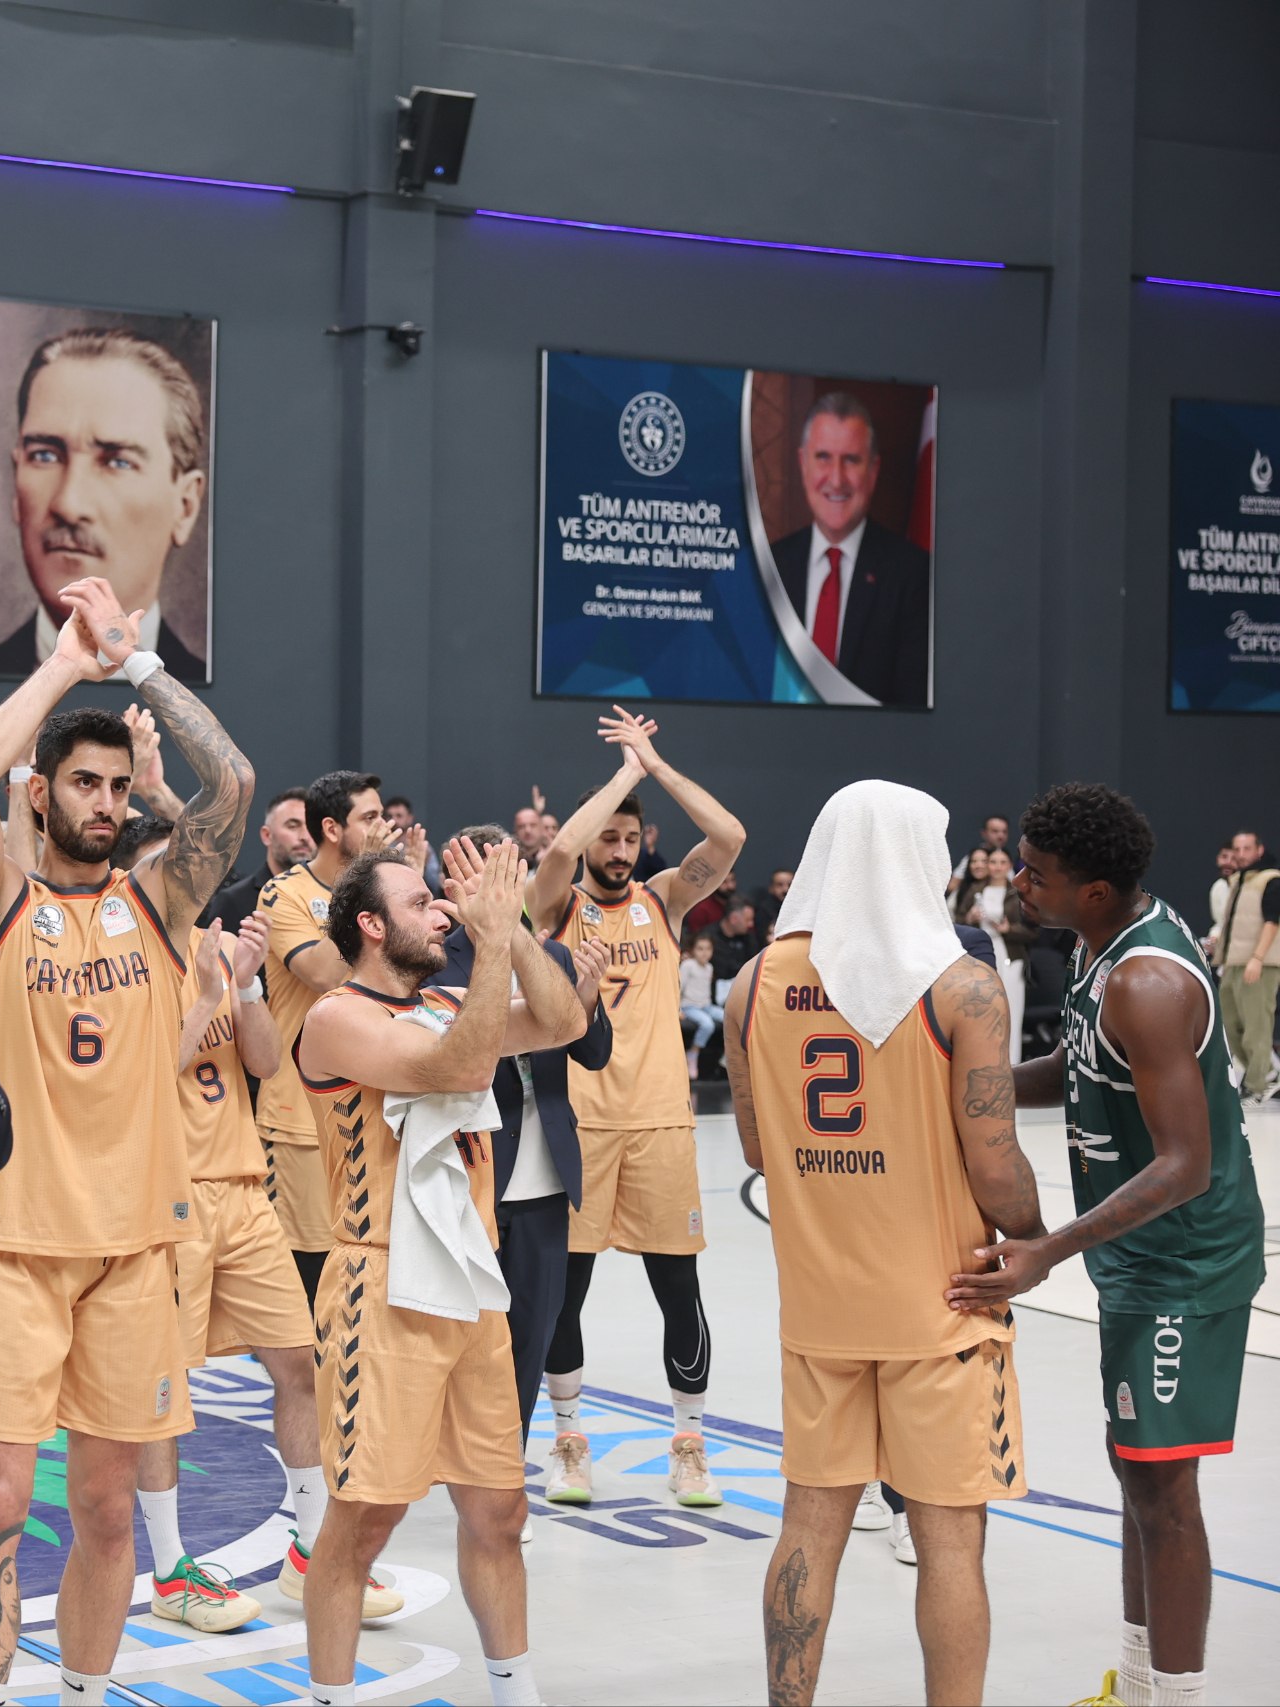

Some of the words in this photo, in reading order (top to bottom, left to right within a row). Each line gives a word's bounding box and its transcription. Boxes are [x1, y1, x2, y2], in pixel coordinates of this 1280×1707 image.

[579, 492, 622, 519] TÜM
[624, 498, 721, 525] ANTRENÖR
[558, 516, 582, 540] VE
[585, 520, 740, 549] SPORCULARIMIZA
[1198, 524, 1234, 551] TÜM
[562, 543, 650, 566] BAŞARILAR
[652, 546, 736, 571] DİLİYORUM
[1178, 548, 1200, 570] VE
[595, 584, 613, 599] Dr.
[613, 585, 649, 600] Osman
[679, 588, 702, 603] BAK
[1188, 573, 1261, 595] BAŞARILAR
[582, 601, 630, 619] GENÇLİK
[630, 603, 643, 618] VE
[643, 603, 674, 620] SPOR
[674, 604, 714, 621] BAKANI
[608, 975, 632, 1011] 7
[785, 985, 838, 1011] GALL
[68, 1011, 105, 1067] 6
[194, 1059, 228, 1105] 9
[801, 1033, 866, 1137] 2
[795, 1147, 886, 1177] ÇAYIROVA
